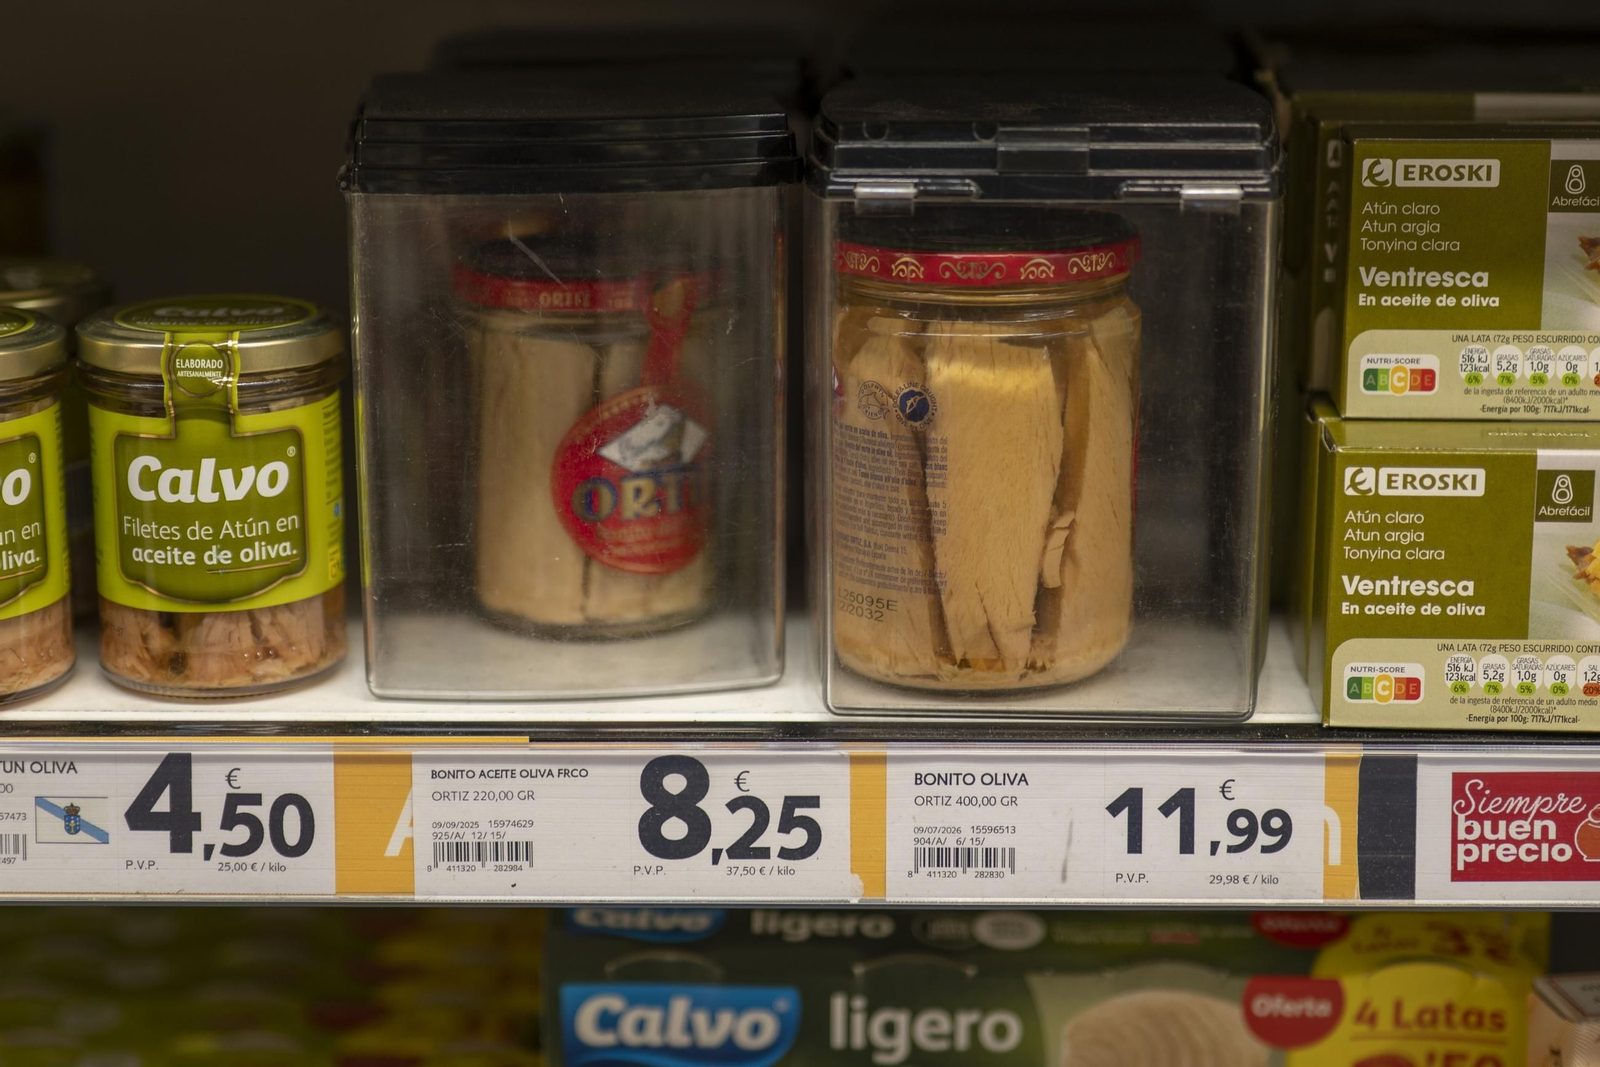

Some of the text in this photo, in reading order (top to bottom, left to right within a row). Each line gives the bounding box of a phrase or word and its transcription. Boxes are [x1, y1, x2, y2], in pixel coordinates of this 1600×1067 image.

[1402, 164, 1493, 182] EROSKI
[1361, 201, 1440, 215] Atún claro
[1552, 196, 1600, 207] Abrefáci
[1361, 220, 1440, 236] Atun argia
[1360, 237, 1460, 253] Tonyina clara
[1358, 266, 1489, 287] Ventresca
[1358, 294, 1500, 307] En aceite de oliva
[1452, 335, 1585, 345] UNA LATA (72g PESO ESCURRIDO)
[176, 358, 223, 369] ELABORADO
[177, 370, 222, 378] ARTESANALMENTE
[127, 455, 290, 503] Calvo
[1386, 473, 1477, 491] EROSKI
[571, 473, 698, 522] ORT
[1344, 509, 1424, 524] Atún claro
[1539, 505, 1590, 517] Abrefácil
[21, 522, 40, 539] en
[124, 512, 299, 540] Filetes de Atún en
[1344, 528, 1424, 545] Atun argia
[132, 541, 297, 565] aceite de oliva.
[1343, 546, 1445, 562] Tonyina clara
[1342, 575, 1474, 596] Ventresca
[1342, 602, 1486, 616] En aceite de oliva
[1437, 644, 1454, 652] UNA
[1457, 644, 1477, 652] LATA
[1480, 644, 1496, 654] (72g
[1500, 644, 1521, 652] PESO
[1523, 644, 1573, 653] ESCURRIDO)
[1447, 664, 1474, 672] 516 kJ
[1445, 673, 1476, 682] 123kcal
[1483, 671, 1504, 682] 5,2g
[1517, 671, 1537, 682] 1,0g
[1553, 672, 1566, 683] 0g
[1377, 681, 1390, 696] C
[1487, 685, 1499, 693] 7%
[1520, 685, 1532, 693] 5%
[1552, 686, 1566, 694] 0%
[1467, 697, 1490, 706] ingesta
[1556, 698, 1576, 706] adulto
[1578, 698, 1597, 706] medio
[1497, 716, 1508, 724] por
[1510, 715, 1529, 724] 100g:
[0, 761, 78, 774] UN OLIVA
[431, 767, 588, 780] BONITO ACEITE OLIVA FRCO
[225, 768, 241, 789] €
[733, 770, 750, 793] €
[914, 773, 1029, 786] BONITO OLIVA
[1219, 779, 1235, 800] €
[431, 790, 535, 803] ORTIZ 220,00 GR
[914, 796, 1018, 808] ORTIZ 400,00 GR
[1453, 779, 1587, 826] Siempre
[124, 752, 315, 861] 4,50
[638, 754, 823, 865] 8,25
[432, 819, 534, 829] 09/09/2025 15974629
[1105, 787, 1293, 856] 11,99
[1457, 815, 1557, 840] buen
[431, 831, 506, 840] 925/A/ 12/ 15/
[913, 825, 1016, 835] 09/07/2026 15596513
[913, 837, 985, 846] 904/A/ 6/ 15/
[1457, 843, 1573, 871] precio
[126, 860, 159, 871] P.V.P.
[218, 862, 247, 873] 25,00
[251, 862, 258, 872] €
[269, 862, 287, 872] kilo
[633, 865, 667, 876] P.V.P.
[726, 866, 757, 877] 37,50
[759, 866, 766, 876] €
[777, 866, 796, 876] kilo
[1115, 874, 1149, 883] P.V.P.
[1209, 874, 1239, 885] 29,98
[1242, 874, 1250, 884] €
[1261, 874, 1279, 884] kilo
[751, 909, 896, 942] ligero
[1252, 993, 1332, 1019] Oferta
[1353, 997, 1507, 1032] 4 Latas
[575, 992, 1023, 1064] Calvo ligero
